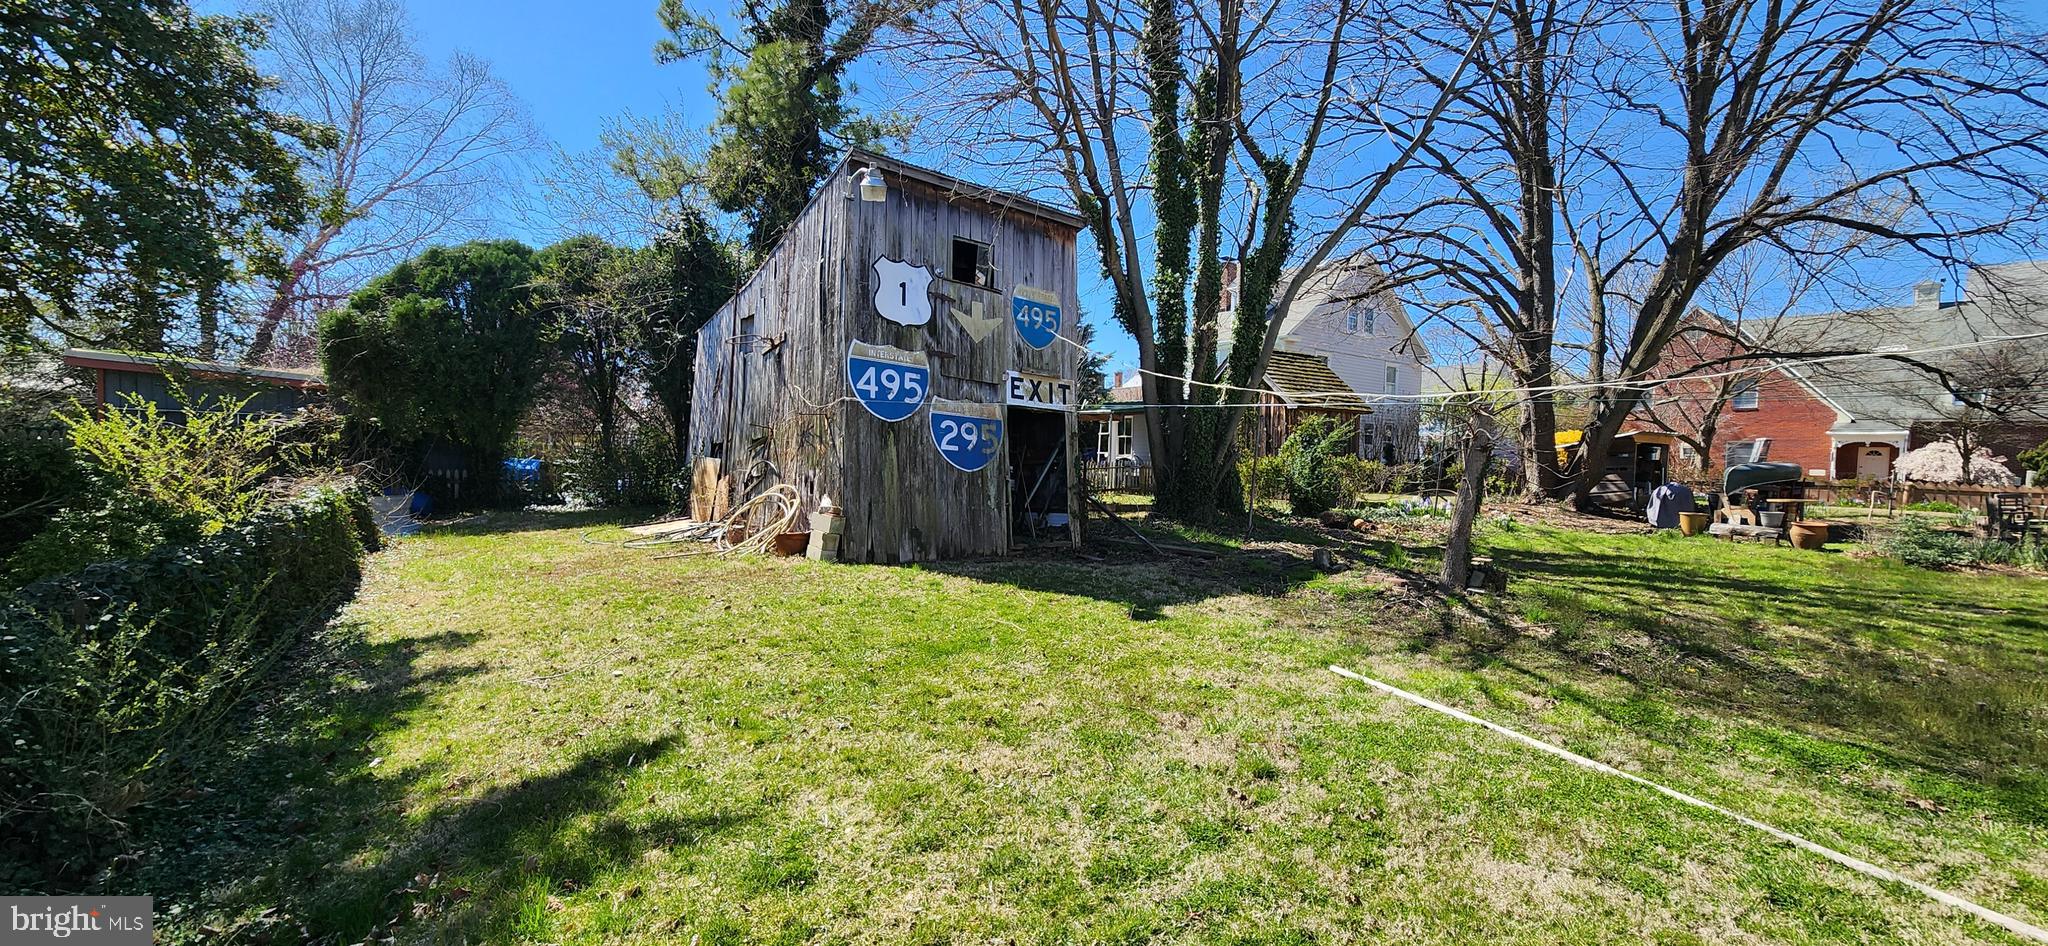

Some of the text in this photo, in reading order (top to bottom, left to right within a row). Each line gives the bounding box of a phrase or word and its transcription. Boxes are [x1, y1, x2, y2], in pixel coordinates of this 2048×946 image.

[898, 282, 907, 307] 1
[1016, 304, 1058, 333] 495
[868, 349, 913, 363] INTERSTATE
[856, 366, 922, 404] 495
[1010, 376, 1073, 406] EXIT
[940, 420, 998, 455] 295
